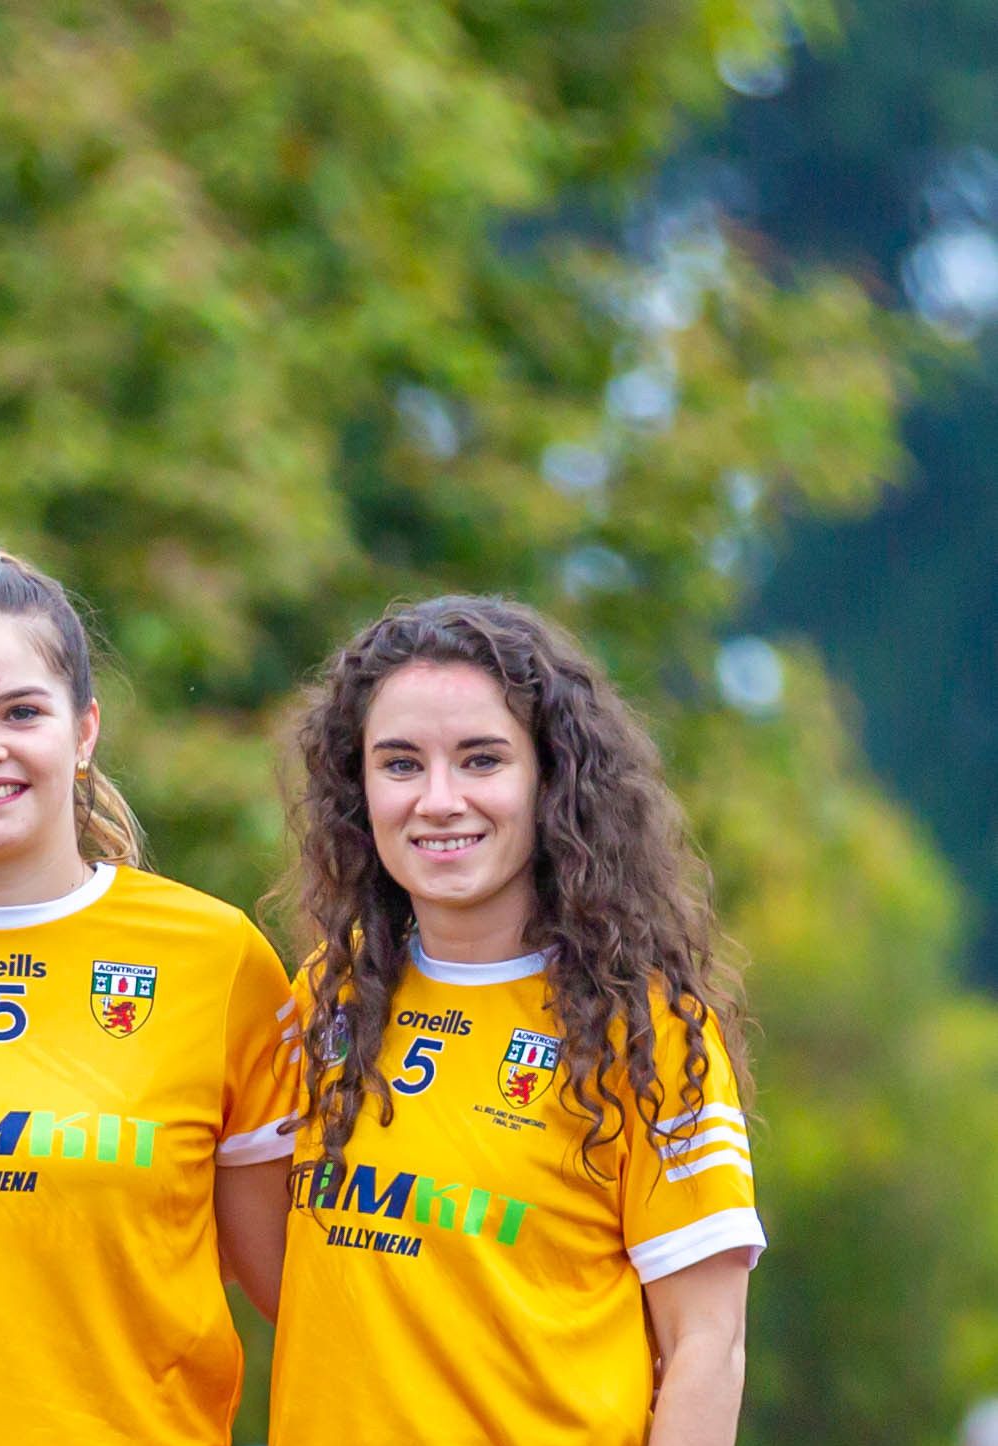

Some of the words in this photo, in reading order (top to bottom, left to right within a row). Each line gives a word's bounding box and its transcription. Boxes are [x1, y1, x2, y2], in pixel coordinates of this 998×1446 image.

[98, 964, 153, 976] AONTROIM
[391, 1036, 444, 1095] 5
[326, 1225, 422, 1257] BALLYMENA
